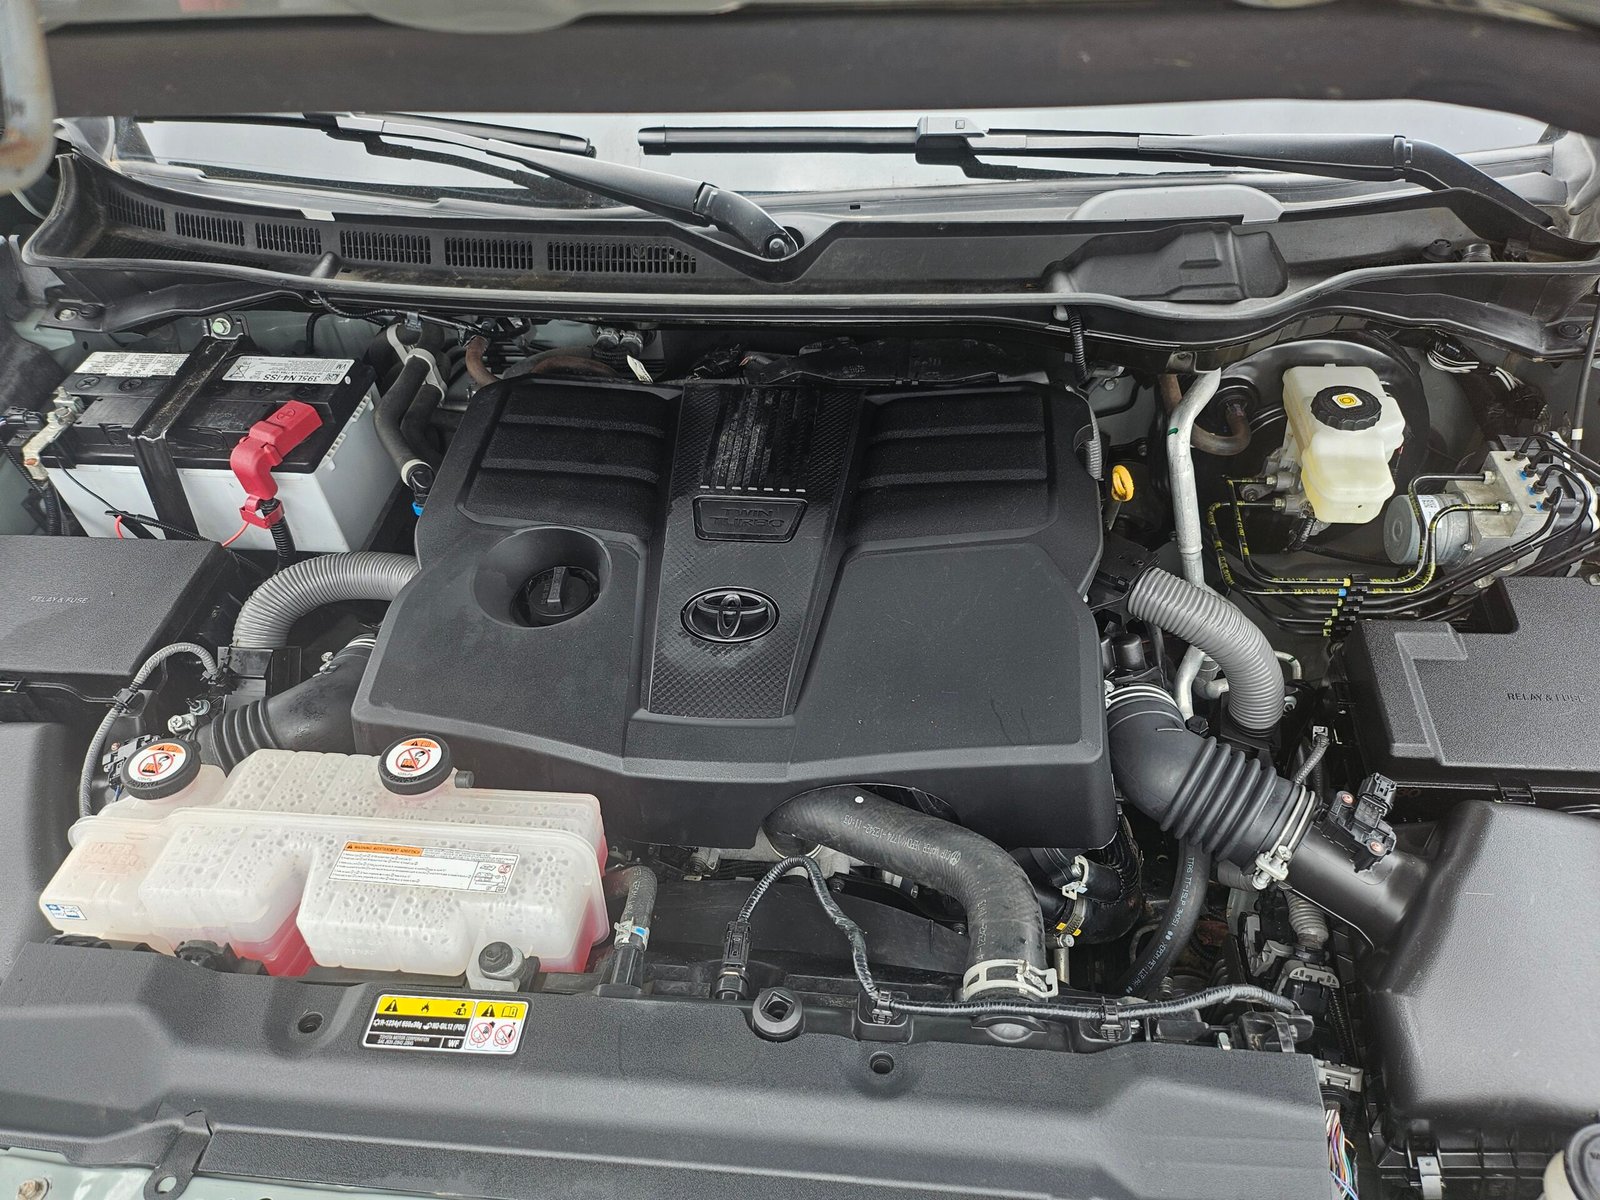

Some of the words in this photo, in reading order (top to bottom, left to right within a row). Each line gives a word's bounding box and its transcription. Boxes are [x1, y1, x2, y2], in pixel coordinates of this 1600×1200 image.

[263, 374, 321, 382] 395LN4-ISS
[721, 507, 773, 517] TWIN
[708, 516, 785, 528] TURBO
[1507, 693, 1542, 701] RELAY
[448, 1039, 460, 1048] WF
